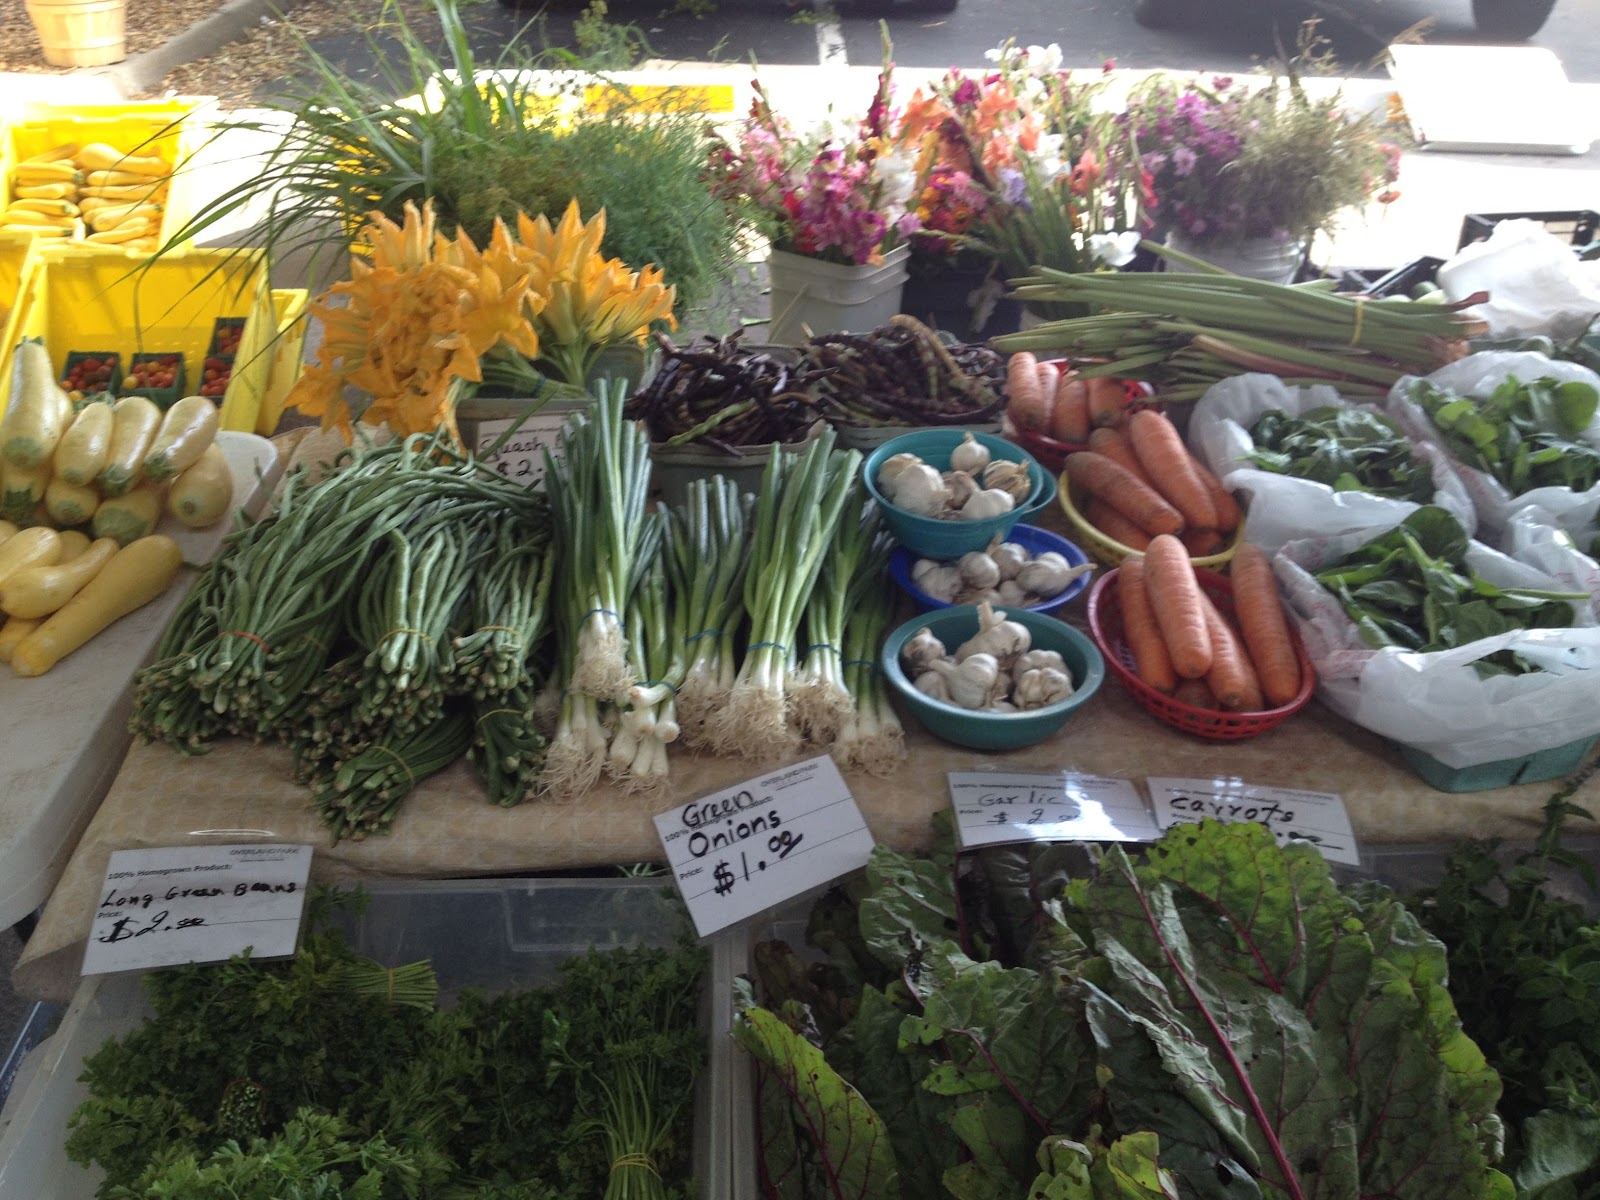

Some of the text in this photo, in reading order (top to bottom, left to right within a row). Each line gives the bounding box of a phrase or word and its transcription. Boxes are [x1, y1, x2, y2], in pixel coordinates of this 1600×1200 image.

[682, 790, 754, 828] Green
[977, 790, 1063, 807] Garlic
[688, 810, 781, 858] Onions
[108, 863, 233, 880] 100% Homegrown Product:
[101, 881, 297, 909] Long Green Beans
